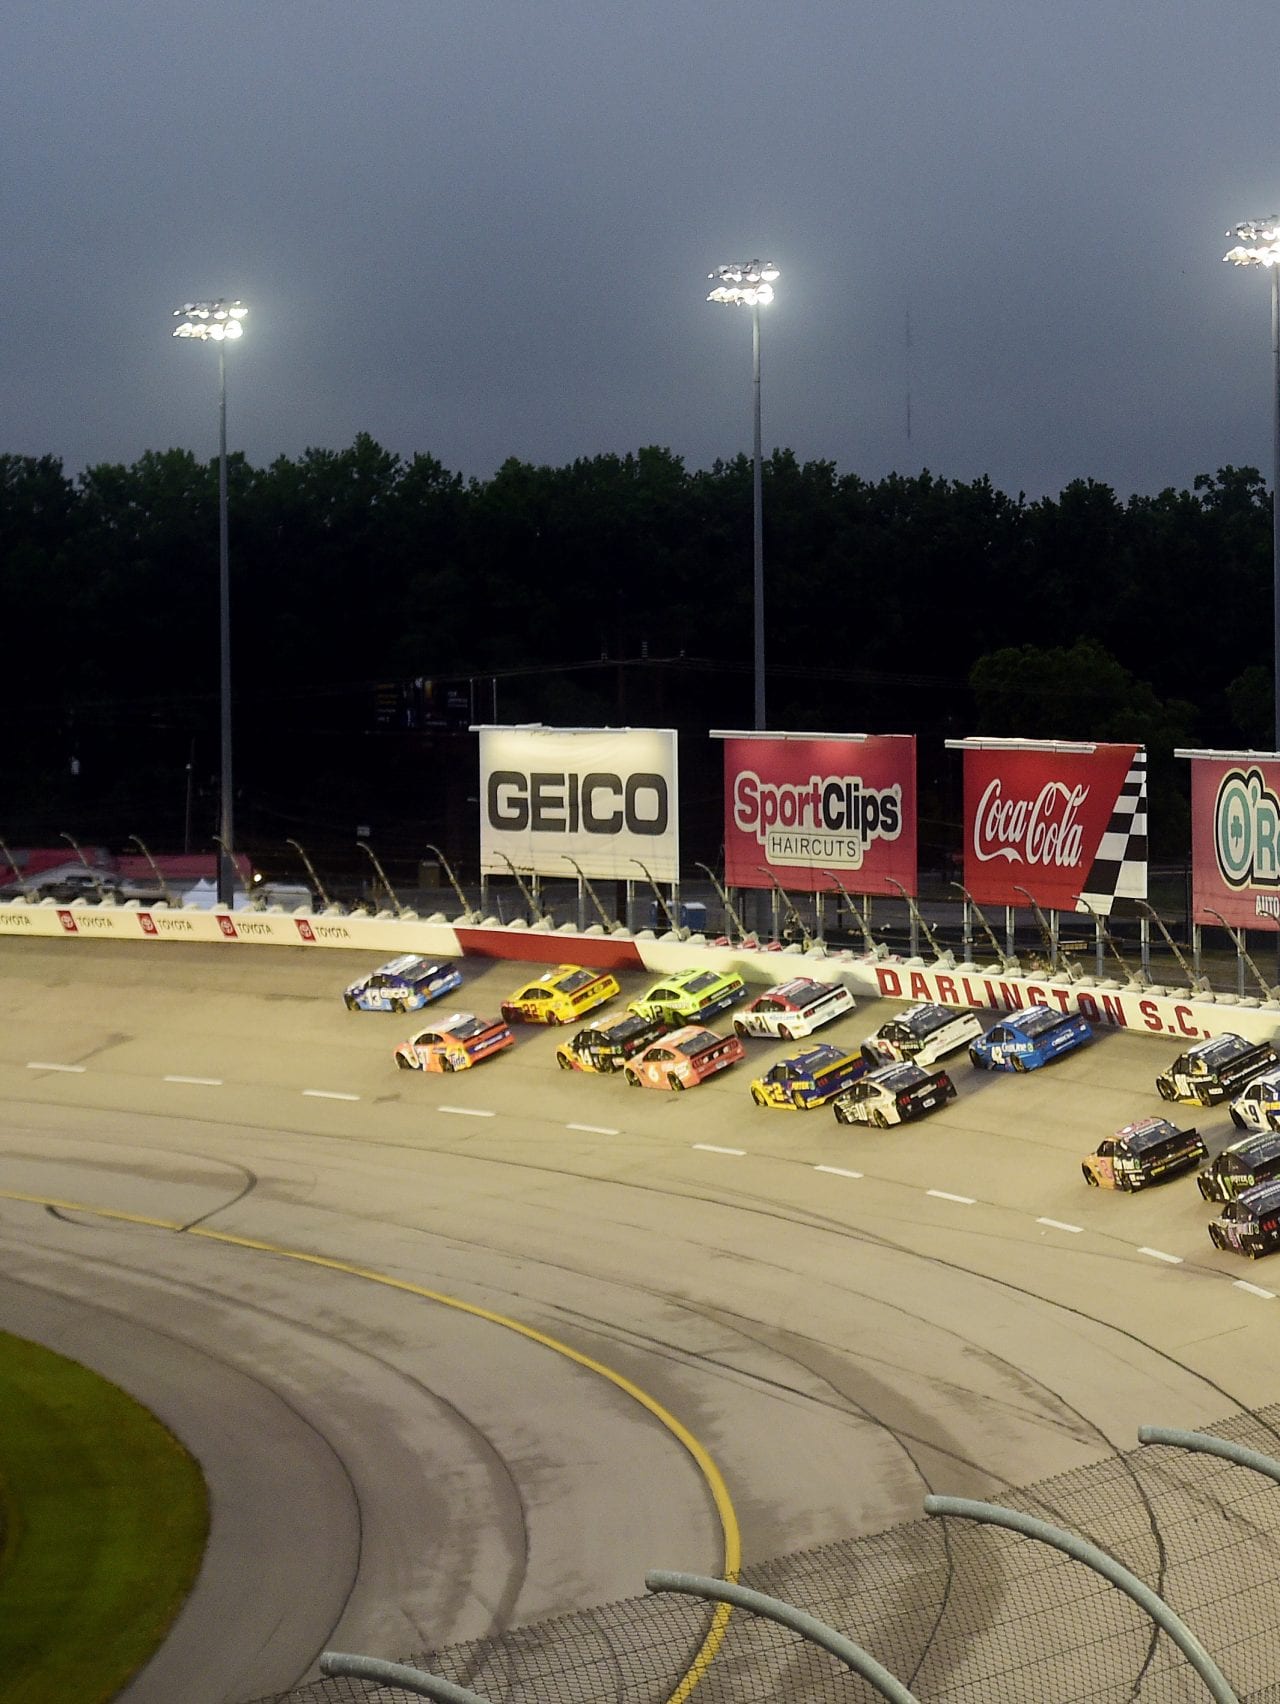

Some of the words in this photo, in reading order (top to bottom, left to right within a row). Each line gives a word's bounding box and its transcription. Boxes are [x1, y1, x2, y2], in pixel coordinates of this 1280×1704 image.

[487, 771, 668, 835] GEICO
[973, 778, 1090, 867] Coca-Cola
[771, 836, 857, 858] HAIRCUTS
[1255, 895, 1280, 918] AUTO
[77, 916, 113, 929] TOYOTA
[157, 919, 194, 932] TOYOTA
[236, 922, 274, 936] TOYOTA
[315, 926, 350, 940] TOYOTA
[875, 967, 1128, 1027] DARLINGTON
[1139, 1000, 1212, 1038] S.C.
[1248, 1104, 1260, 1124] 9
